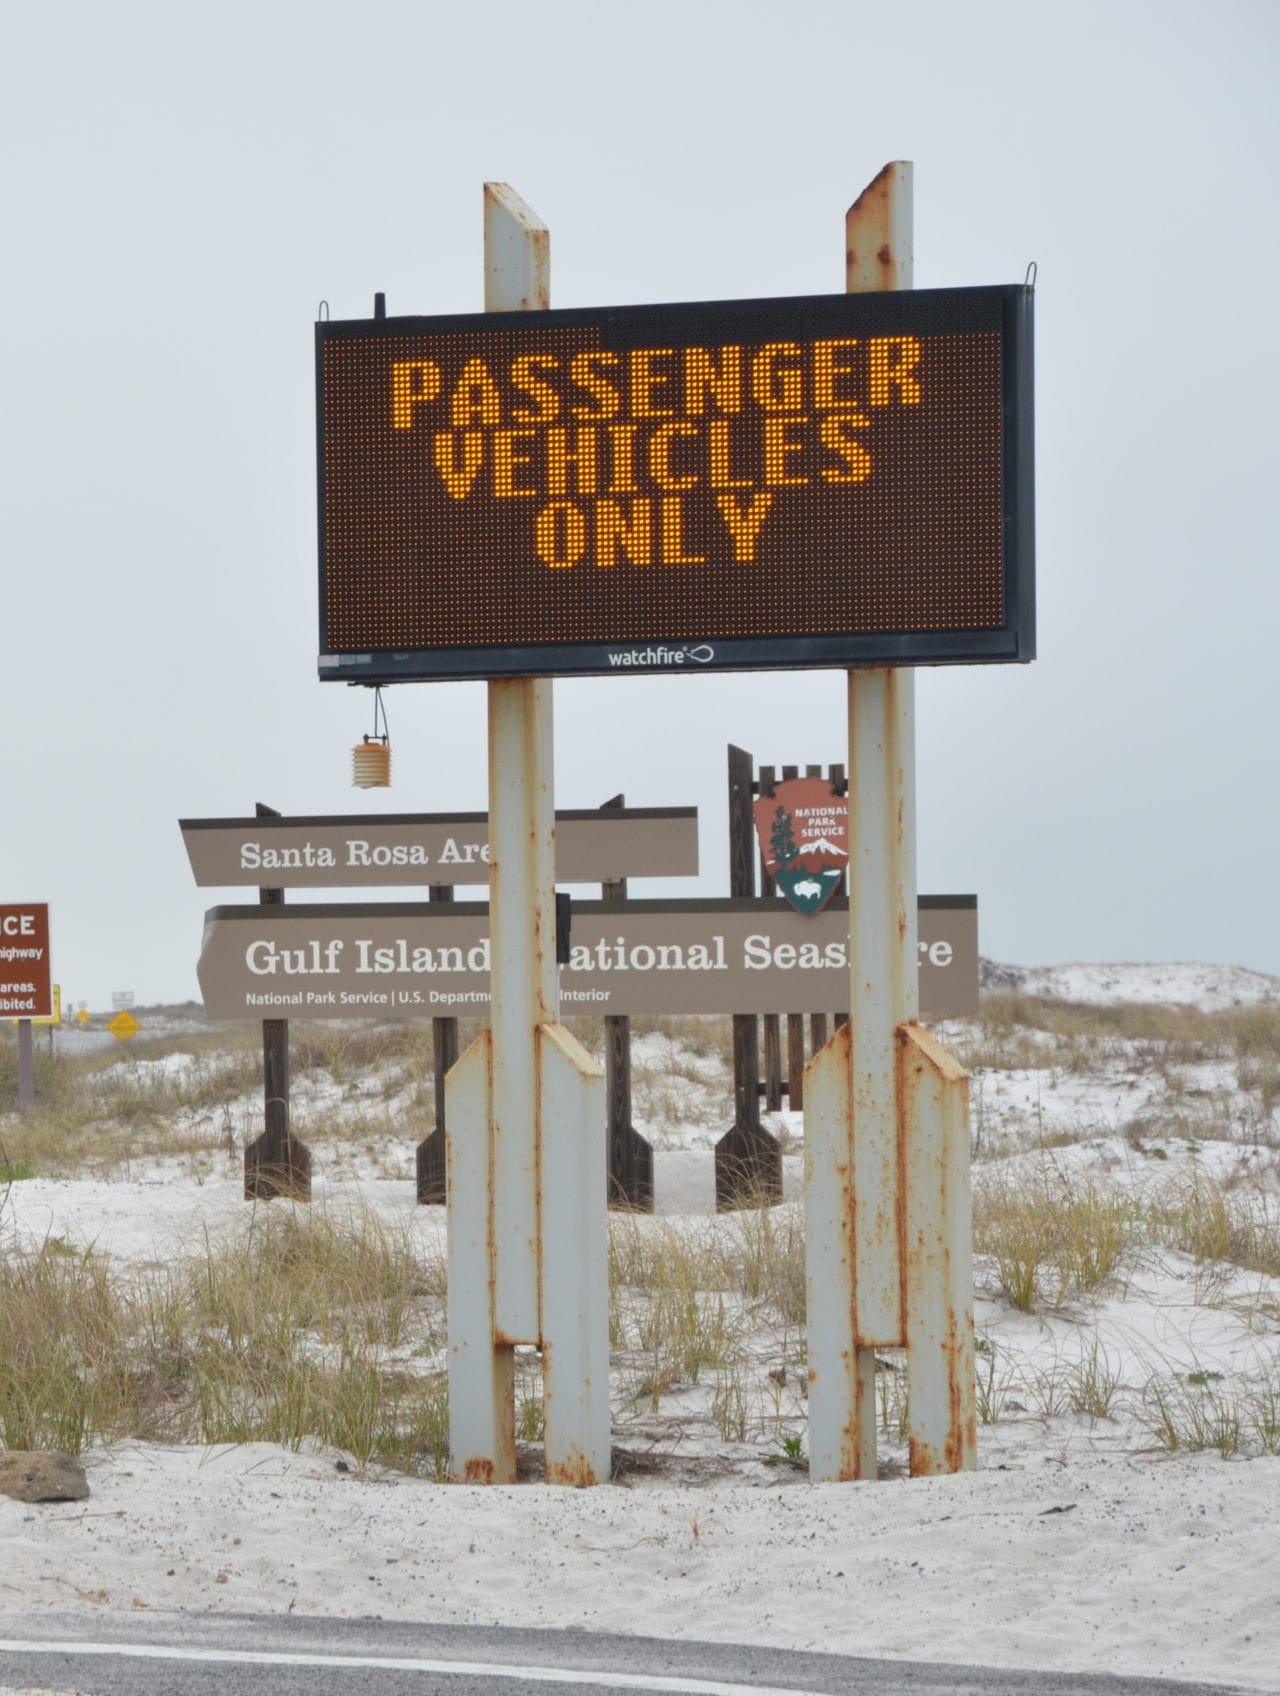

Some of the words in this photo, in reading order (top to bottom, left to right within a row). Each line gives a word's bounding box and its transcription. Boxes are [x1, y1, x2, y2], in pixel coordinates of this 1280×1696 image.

[391, 335, 922, 430] PASSENGER
[433, 413, 873, 500] VEHICLES
[534, 492, 774, 569] ONLY
[795, 806, 848, 818] NATIONAL
[808, 817, 836, 827] PARK
[801, 826, 845, 838] SERVICE
[240, 841, 336, 870] Santa
[345, 839, 429, 868] Rosa
[437, 837, 490, 864] Are
[245, 940, 344, 976] Gulf
[354, 938, 492, 974] Island
[560, 935, 729, 971] ational
[0, 982, 37, 993] areas.
[246, 992, 303, 1006] National
[307, 992, 336, 1004] Park
[340, 991, 388, 1004] Service
[399, 991, 425, 1003] U.S.
[560, 988, 611, 1002] Interior
